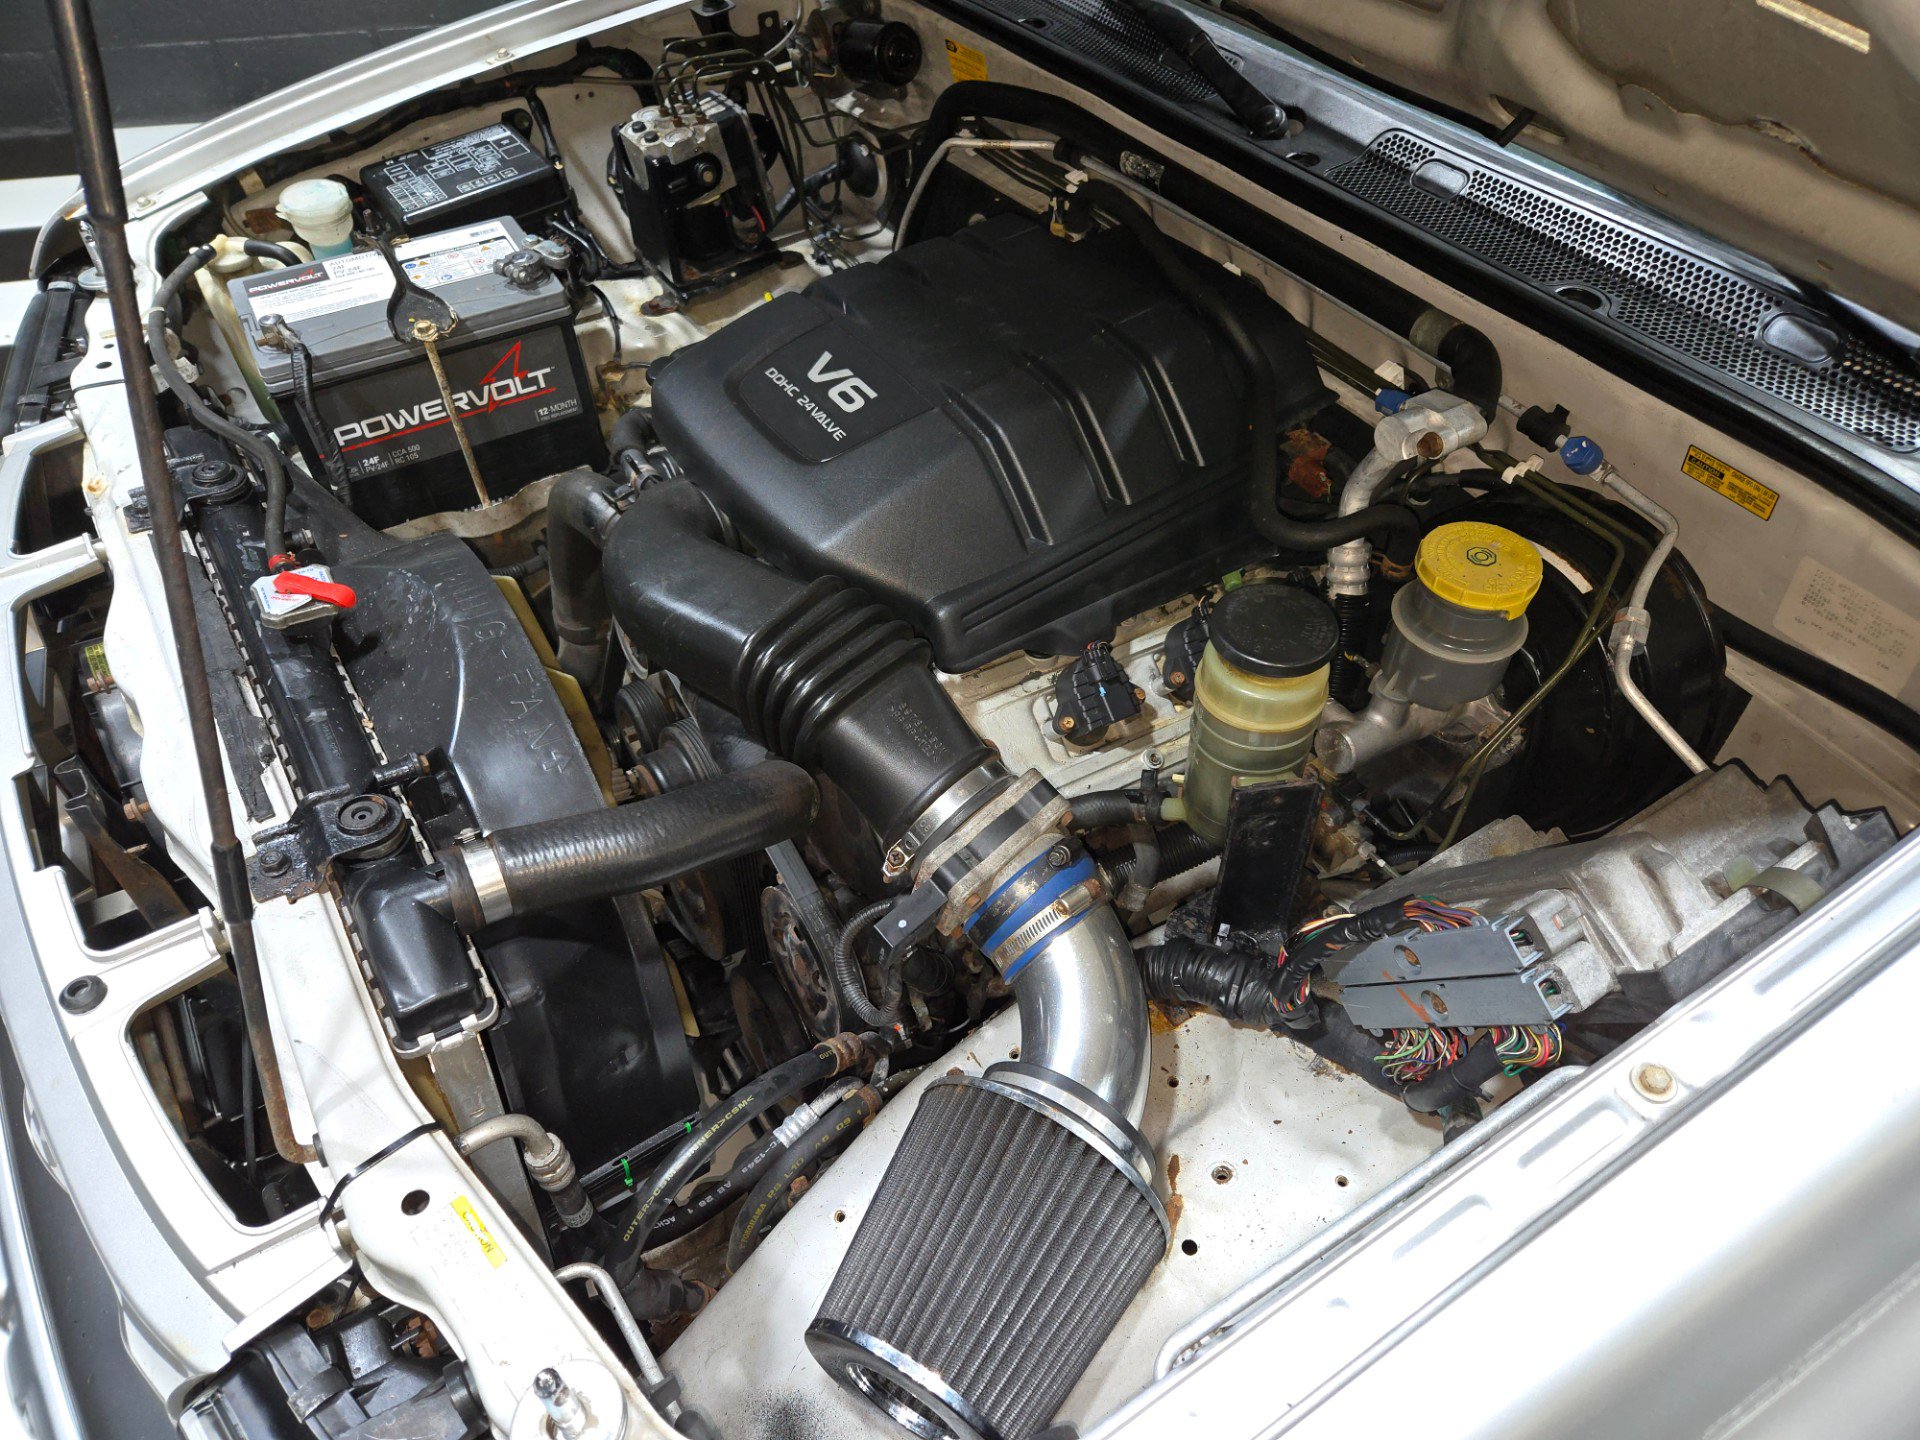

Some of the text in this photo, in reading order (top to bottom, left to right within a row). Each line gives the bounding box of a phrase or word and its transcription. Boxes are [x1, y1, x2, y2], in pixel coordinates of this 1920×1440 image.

[807, 350, 878, 413] V6
[334, 367, 551, 446] POWERVOLT
[538, 398, 577, 416] 12-MONTH
[765, 367, 847, 441] DOHC 24VALVE
[408, 444, 421, 453] 500
[363, 455, 380, 467] 24F
[406, 453, 419, 463] 105
